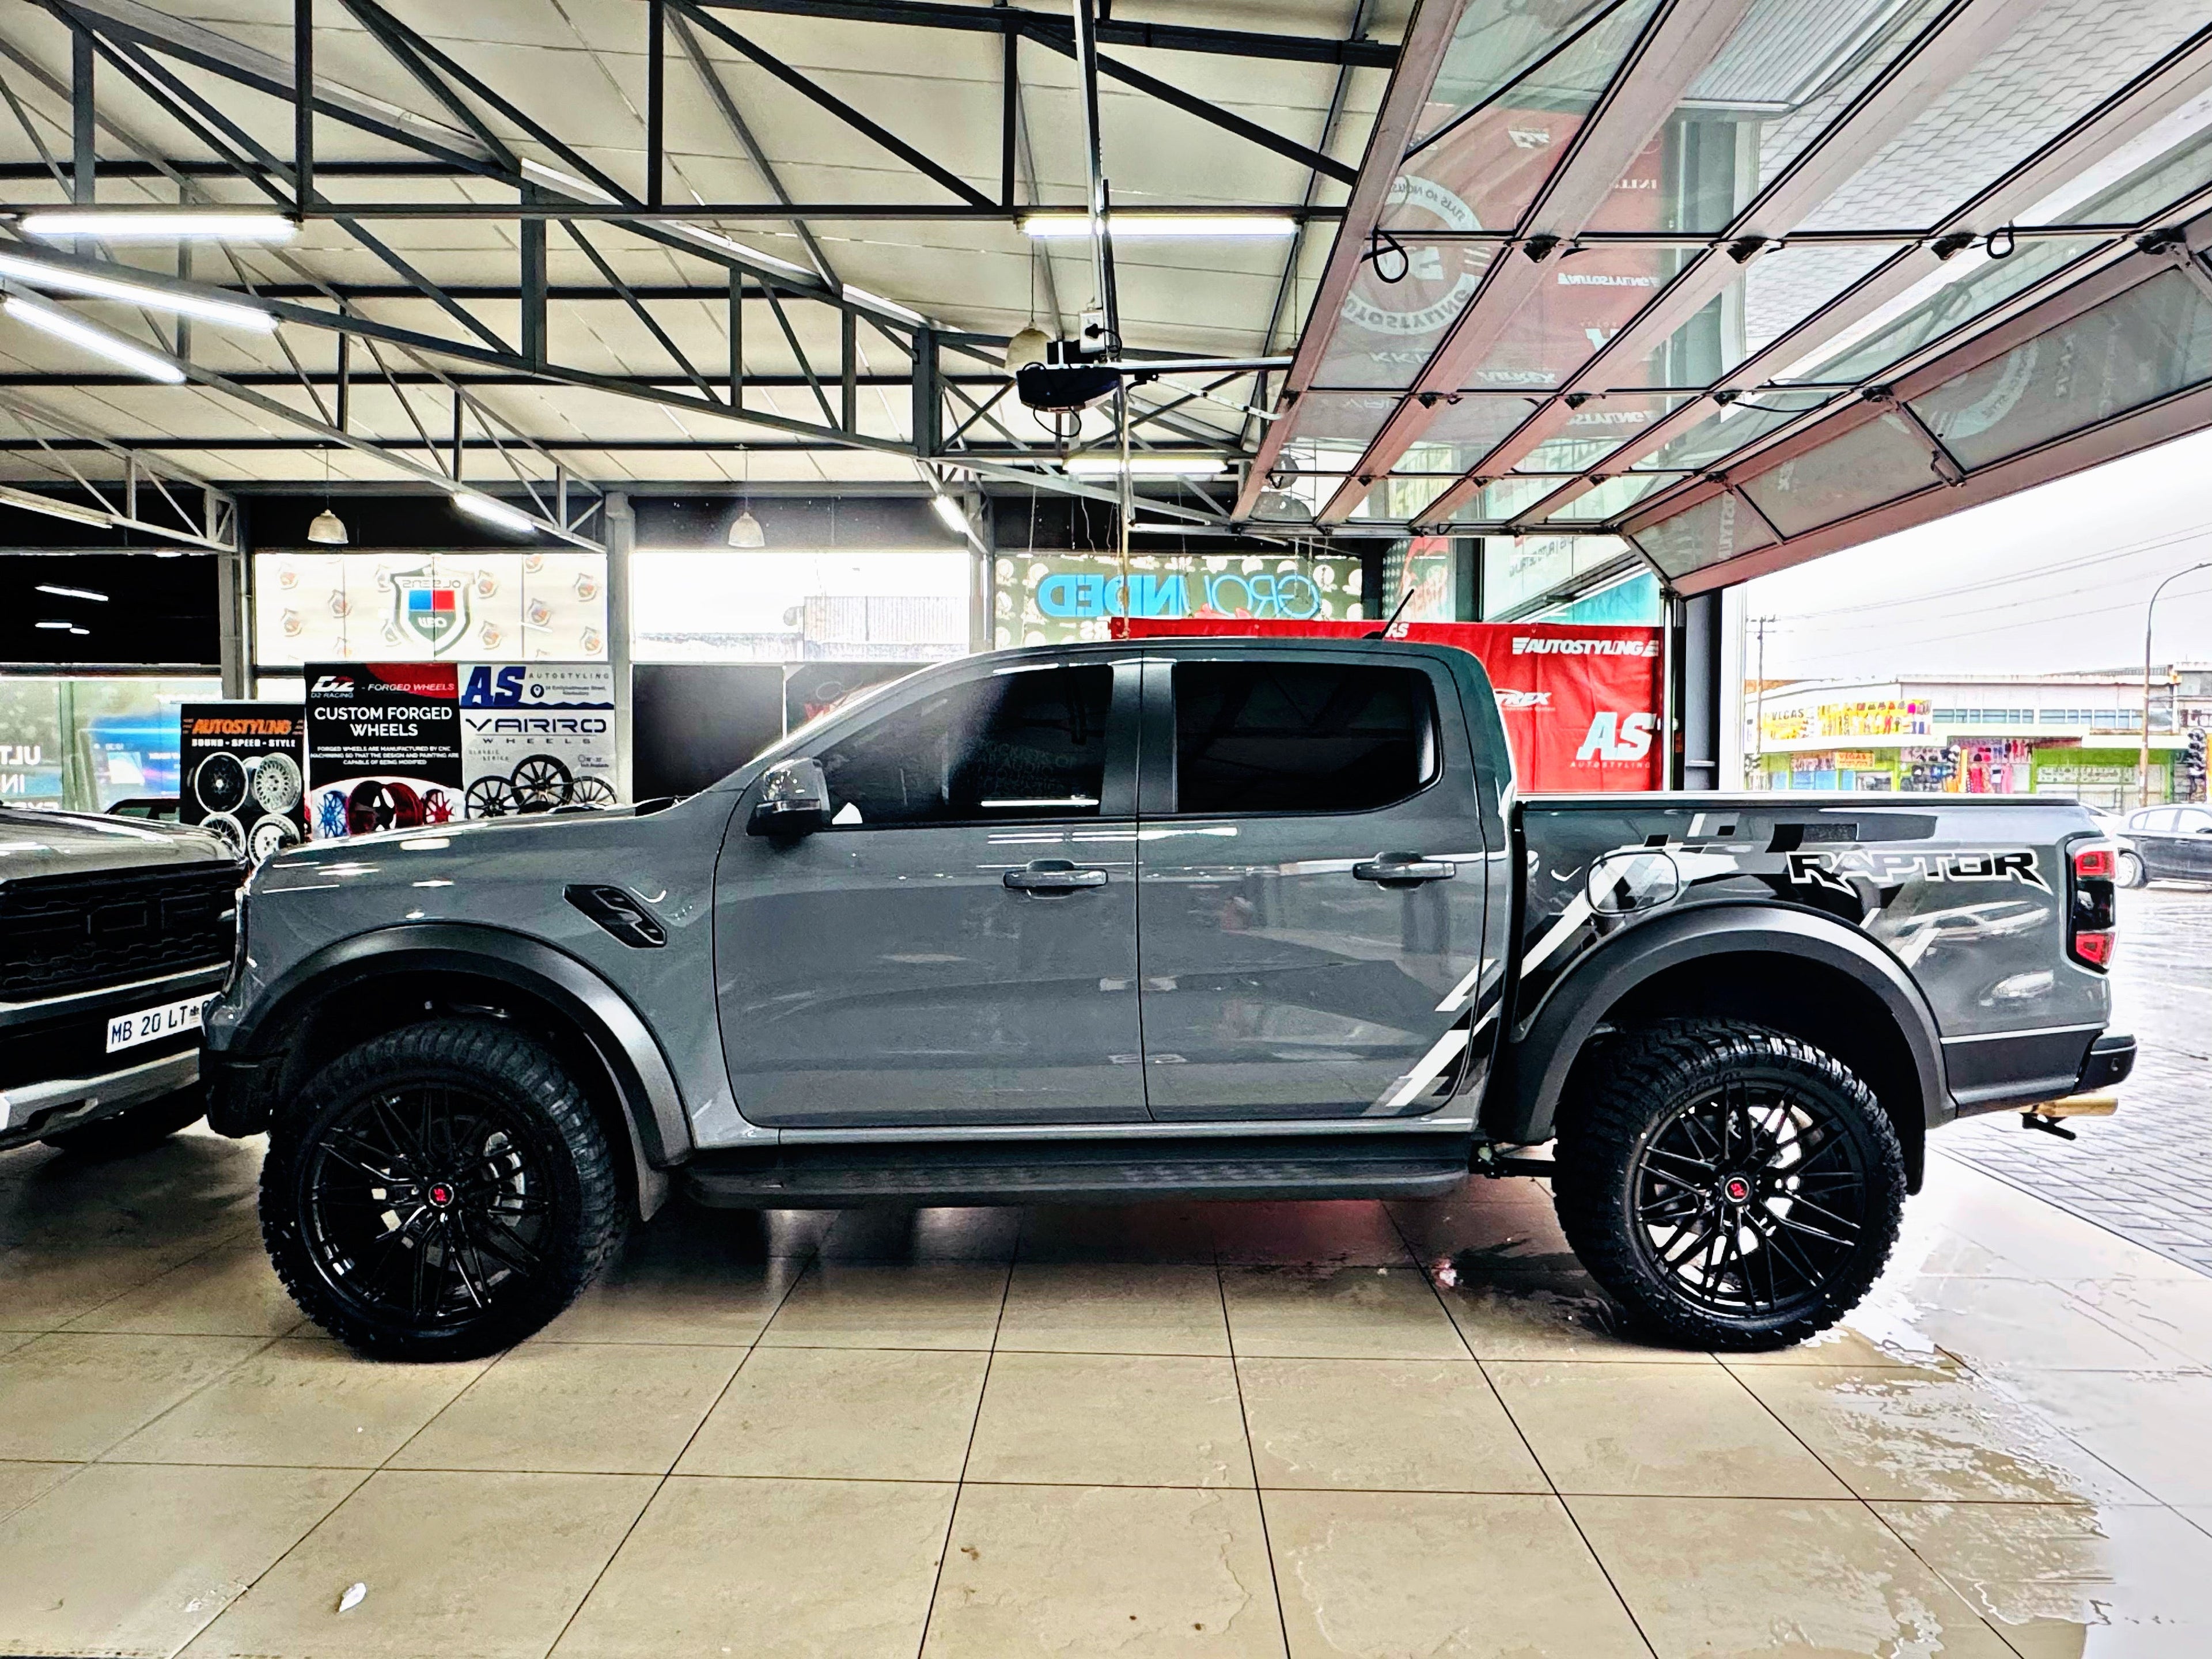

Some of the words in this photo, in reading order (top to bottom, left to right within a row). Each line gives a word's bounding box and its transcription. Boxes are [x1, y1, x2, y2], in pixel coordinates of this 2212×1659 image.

[1526, 638, 1643, 656] AUTOSTYLING
[413, 683, 455, 691] WHEELS
[460, 666, 526, 706] AS
[314, 707, 384, 721] CUSTOM
[387, 707, 453, 720] FORGED
[1772, 708, 1804, 721] VEGAS
[192, 718, 292, 735] AUTOSTYLING
[350, 723, 419, 737] WHEELS
[465, 718, 607, 733] VARRO
[191, 738, 224, 747] SOUND
[231, 738, 261, 748] SPEED
[268, 739, 296, 748] STYLE
[1785, 849, 2054, 898] RAPTOR
[112, 1020, 132, 1045] MB
[141, 1013, 161, 1036] 20
[168, 1005, 188, 1029] LT
